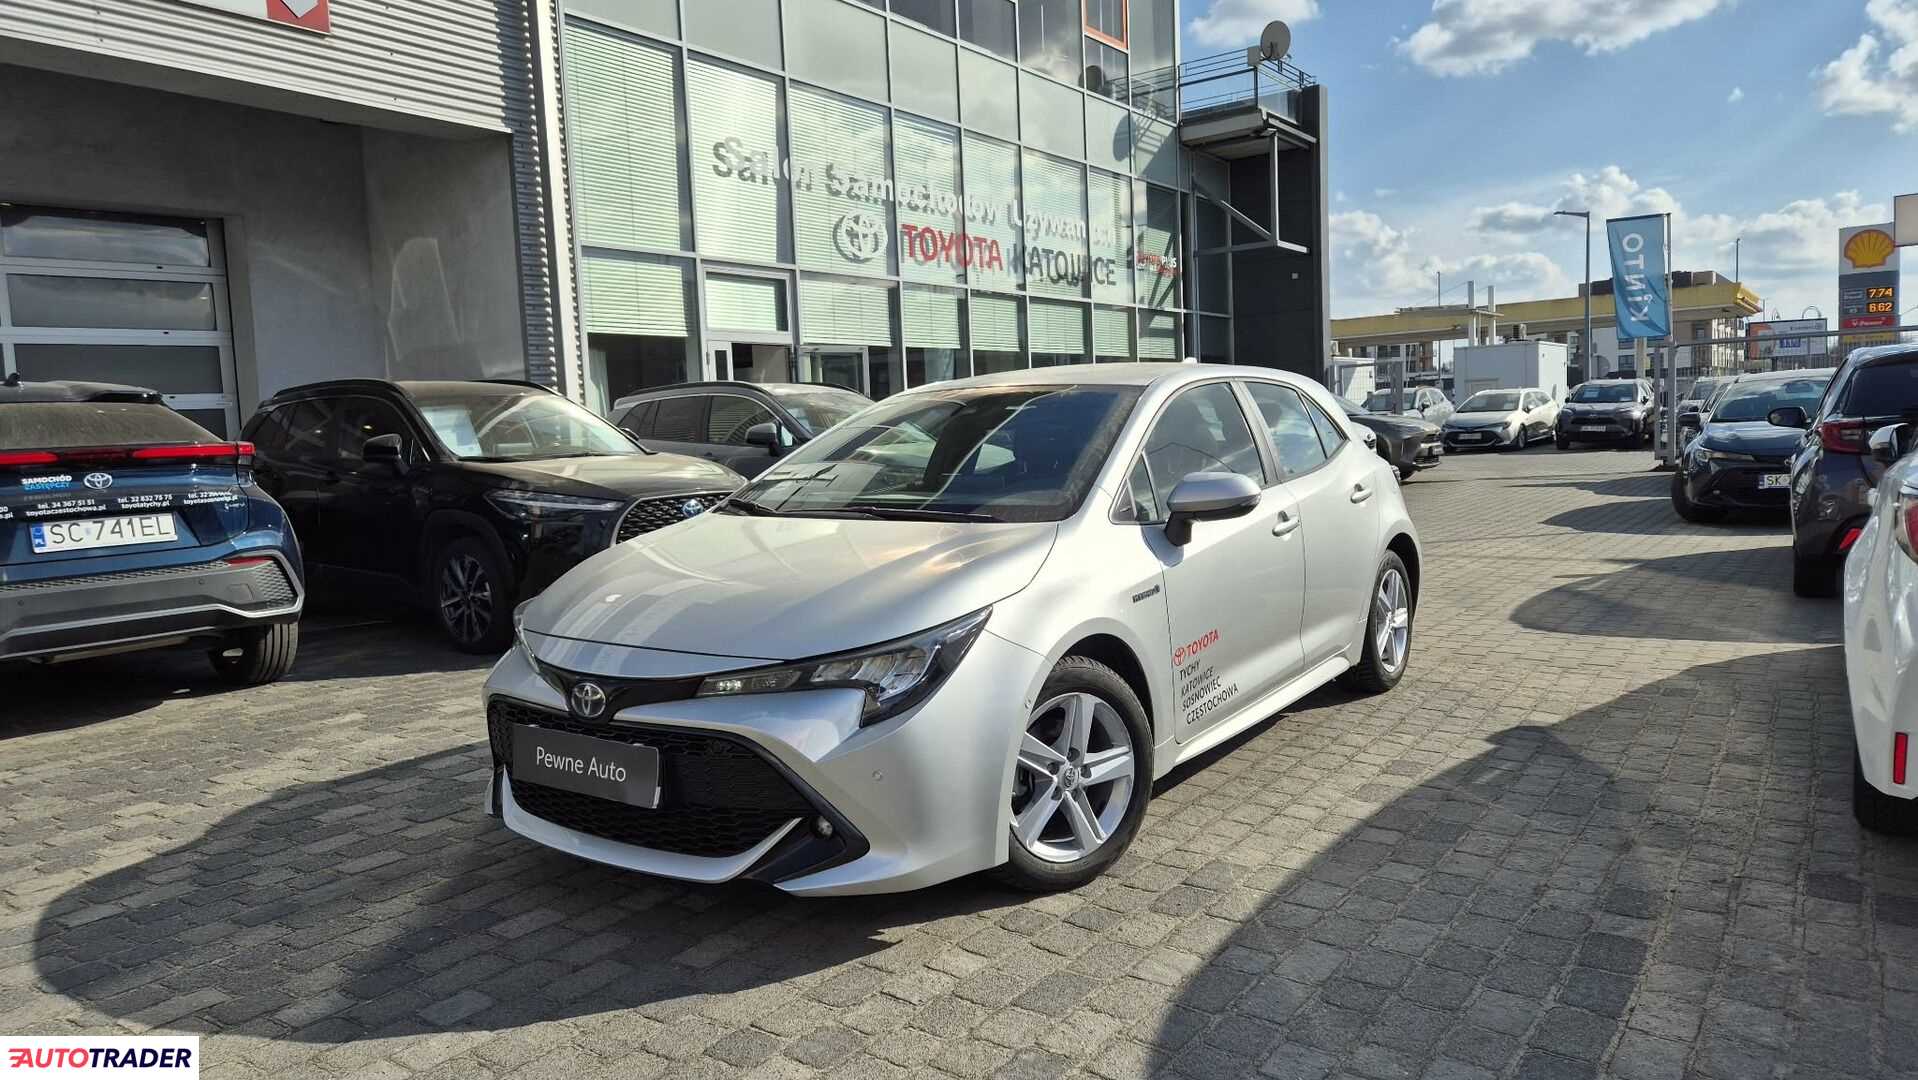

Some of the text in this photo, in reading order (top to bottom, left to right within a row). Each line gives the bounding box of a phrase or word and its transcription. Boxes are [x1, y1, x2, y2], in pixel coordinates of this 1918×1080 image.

[901, 223, 1003, 271] TOYOTA
[21, 474, 73, 485] SAMOCHÓD
[1766, 475, 1782, 486] SK
[26, 505, 107, 517] toyotaczestochowa.pl
[117, 496, 129, 504] tel.
[130, 495, 139, 503] 32
[121, 500, 170, 510] toyotatychy.pl
[50, 523, 84, 544] SC
[92, 517, 170, 540] 741EL
[1186, 628, 1220, 657] TOYOTA
[1180, 658, 1201, 681] TYCHY
[1181, 666, 1213, 698] KATOWICE
[1182, 676, 1222, 712] SOSNOWIEC
[536, 746, 626, 782] Pewne Auto
